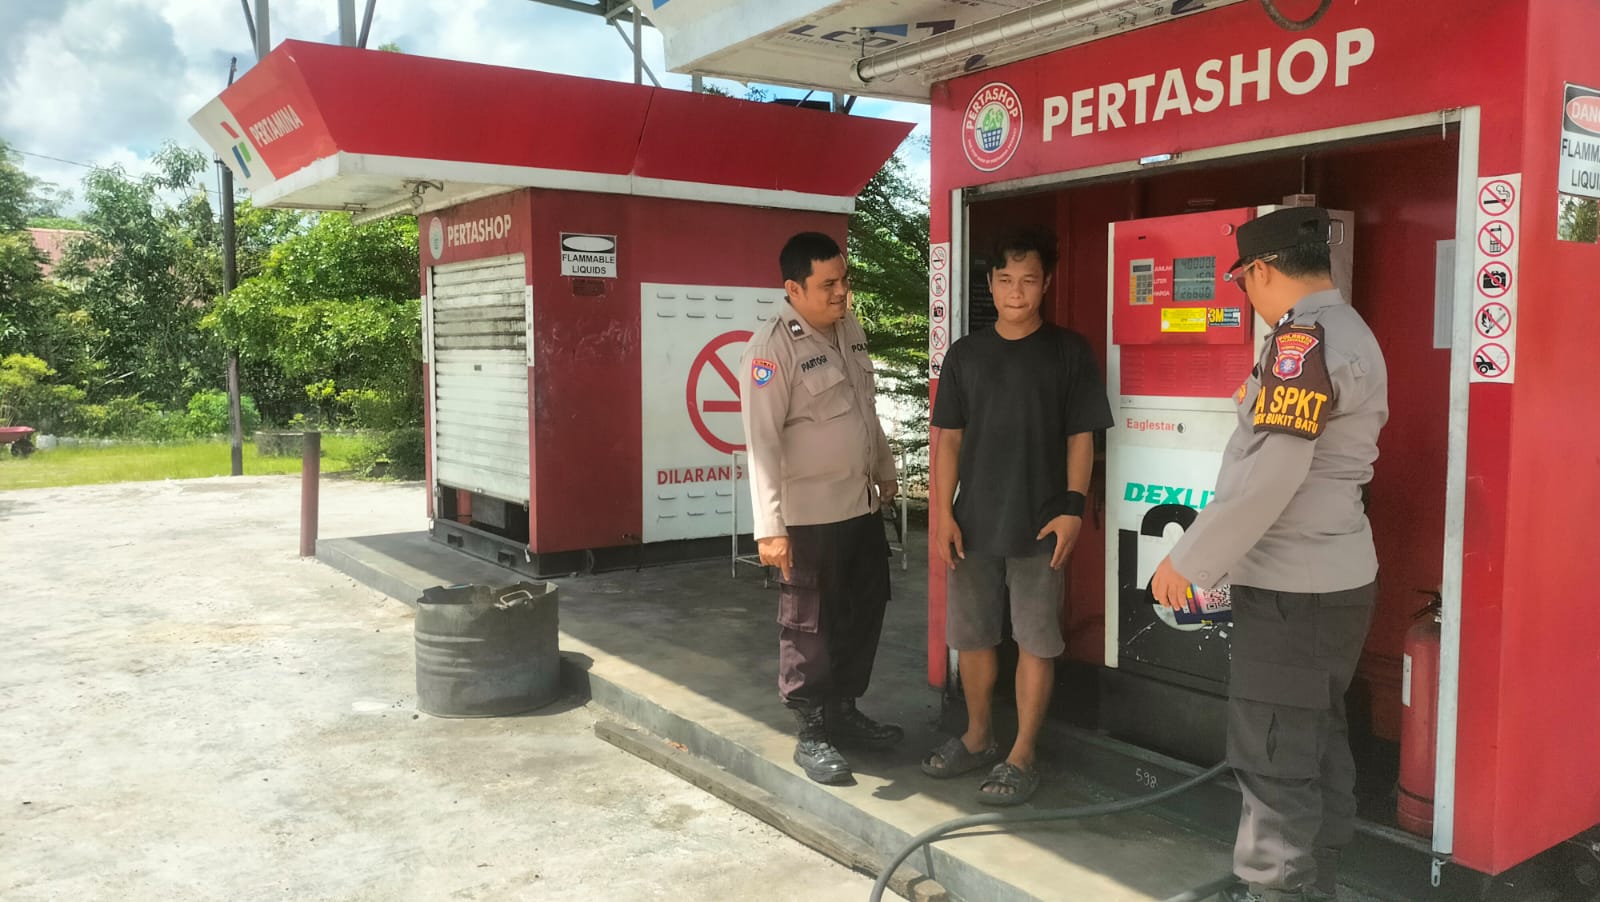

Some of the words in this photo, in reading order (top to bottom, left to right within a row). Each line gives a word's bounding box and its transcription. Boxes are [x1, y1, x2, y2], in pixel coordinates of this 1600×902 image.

[1043, 27, 1375, 142] PERTASHOP
[965, 87, 1019, 130] PERTASHOP
[1571, 101, 1600, 120] DAN
[249, 104, 304, 148] PERTAMINA
[1561, 138, 1600, 164] FLAMM
[1571, 168, 1600, 190] LIQUI
[447, 214, 512, 248] PERTASHOP
[561, 253, 615, 264] FLAMMABLE
[572, 265, 607, 275] LIQUIDS
[1209, 308, 1224, 322] 3M
[1270, 385, 1328, 421] SPKT
[1126, 417, 1175, 431] Eaglestar
[1265, 412, 1294, 427] BUKIT
[1295, 416, 1319, 434] BATU
[1123, 482, 1215, 510] DEXLI
[1135, 767, 1157, 789] 598
